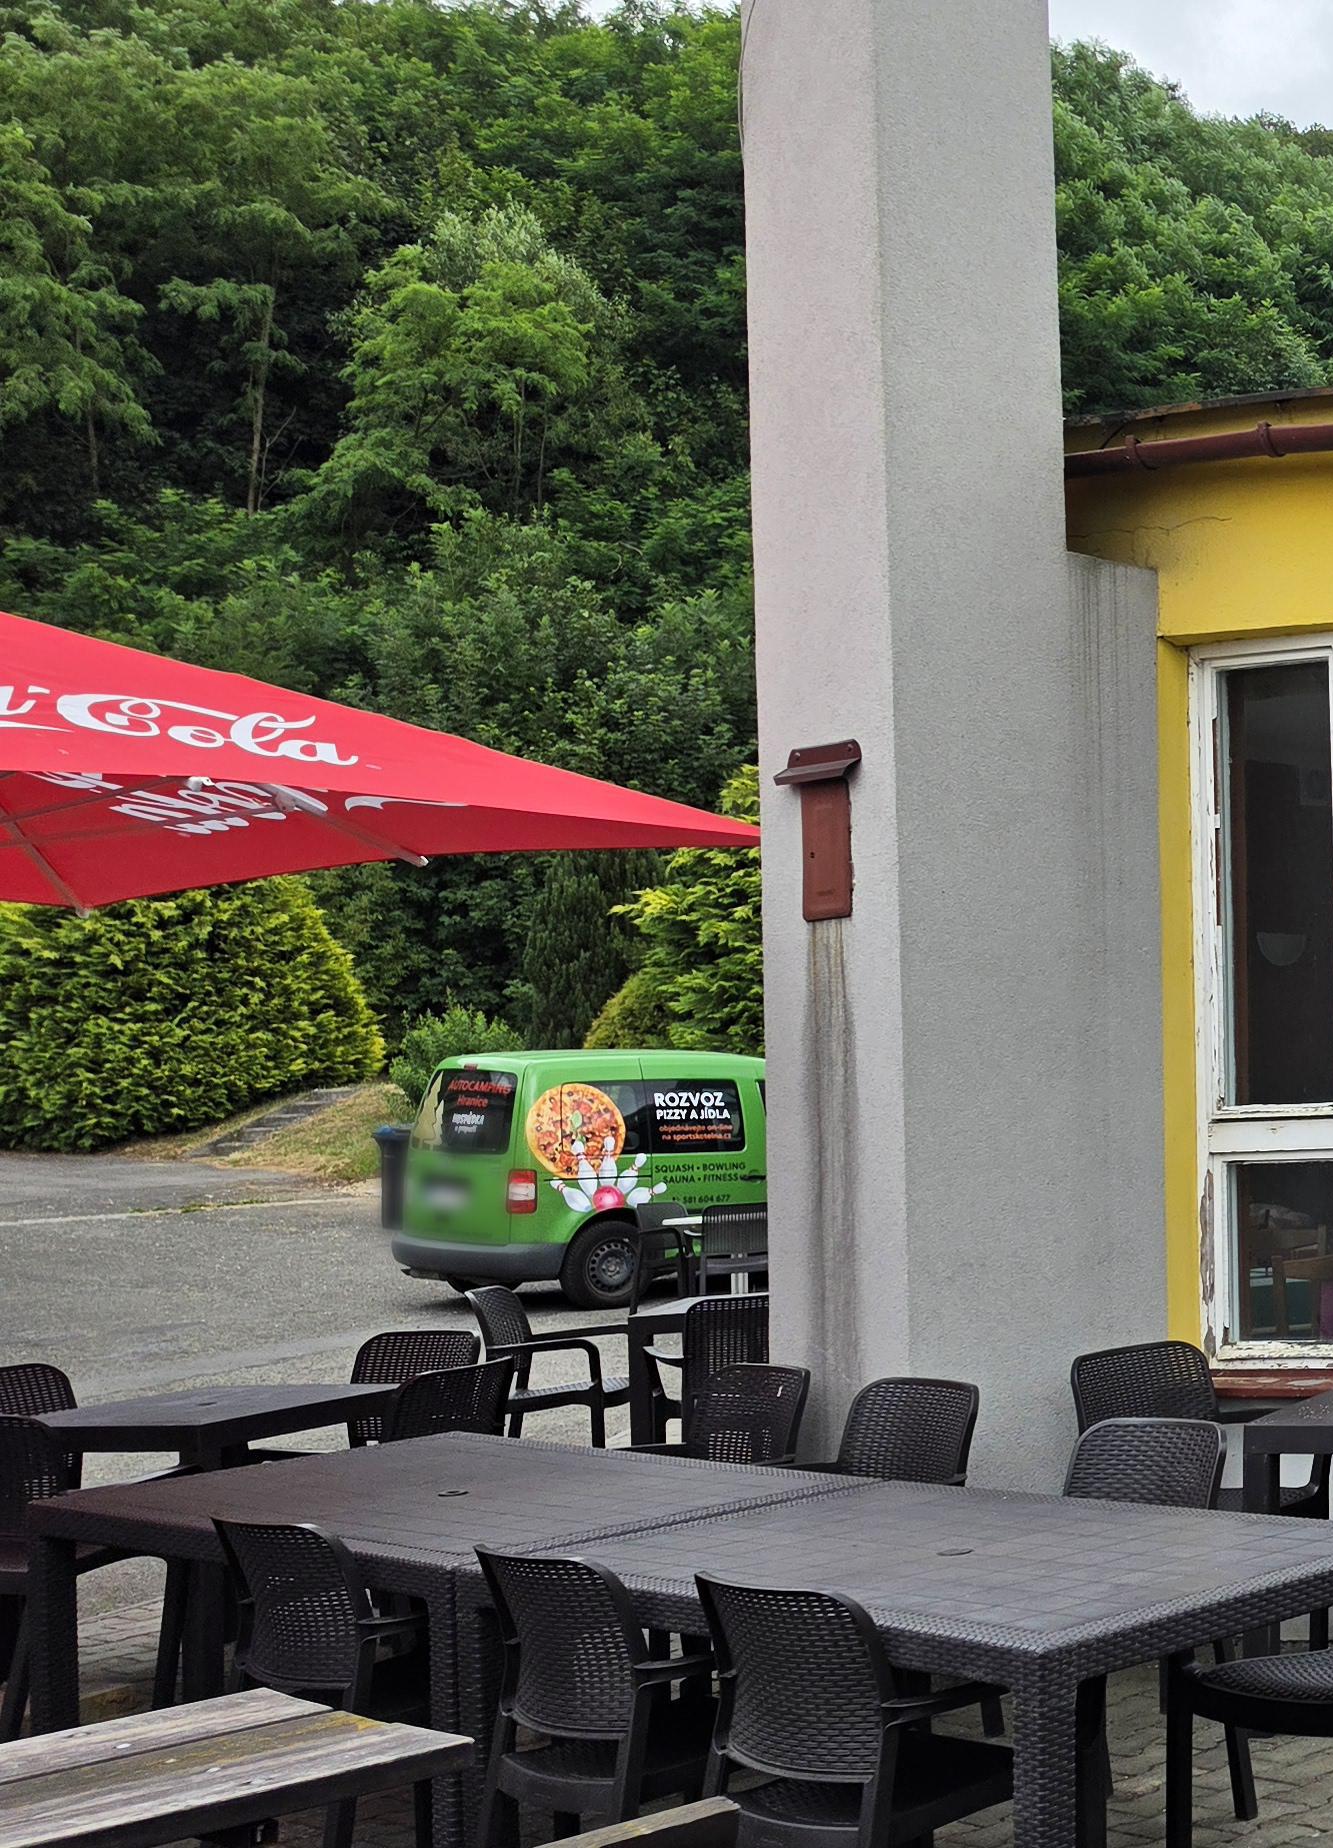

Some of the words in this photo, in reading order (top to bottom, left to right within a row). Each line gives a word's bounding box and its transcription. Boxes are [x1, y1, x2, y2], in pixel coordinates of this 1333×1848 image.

[448, 1080, 512, 1094] AUTOCAMPING
[654, 1092, 725, 1107] ROZVOZ
[656, 1108, 687, 1120] PIZZY
[689, 1108, 698, 1120] A
[699, 1106, 731, 1120] JÍDLA
[655, 1164, 694, 1173] SQUASH
[702, 1162, 746, 1171] BOWLING
[663, 1175, 695, 1184] SAUNA
[703, 1173, 738, 1183] FITNESS
